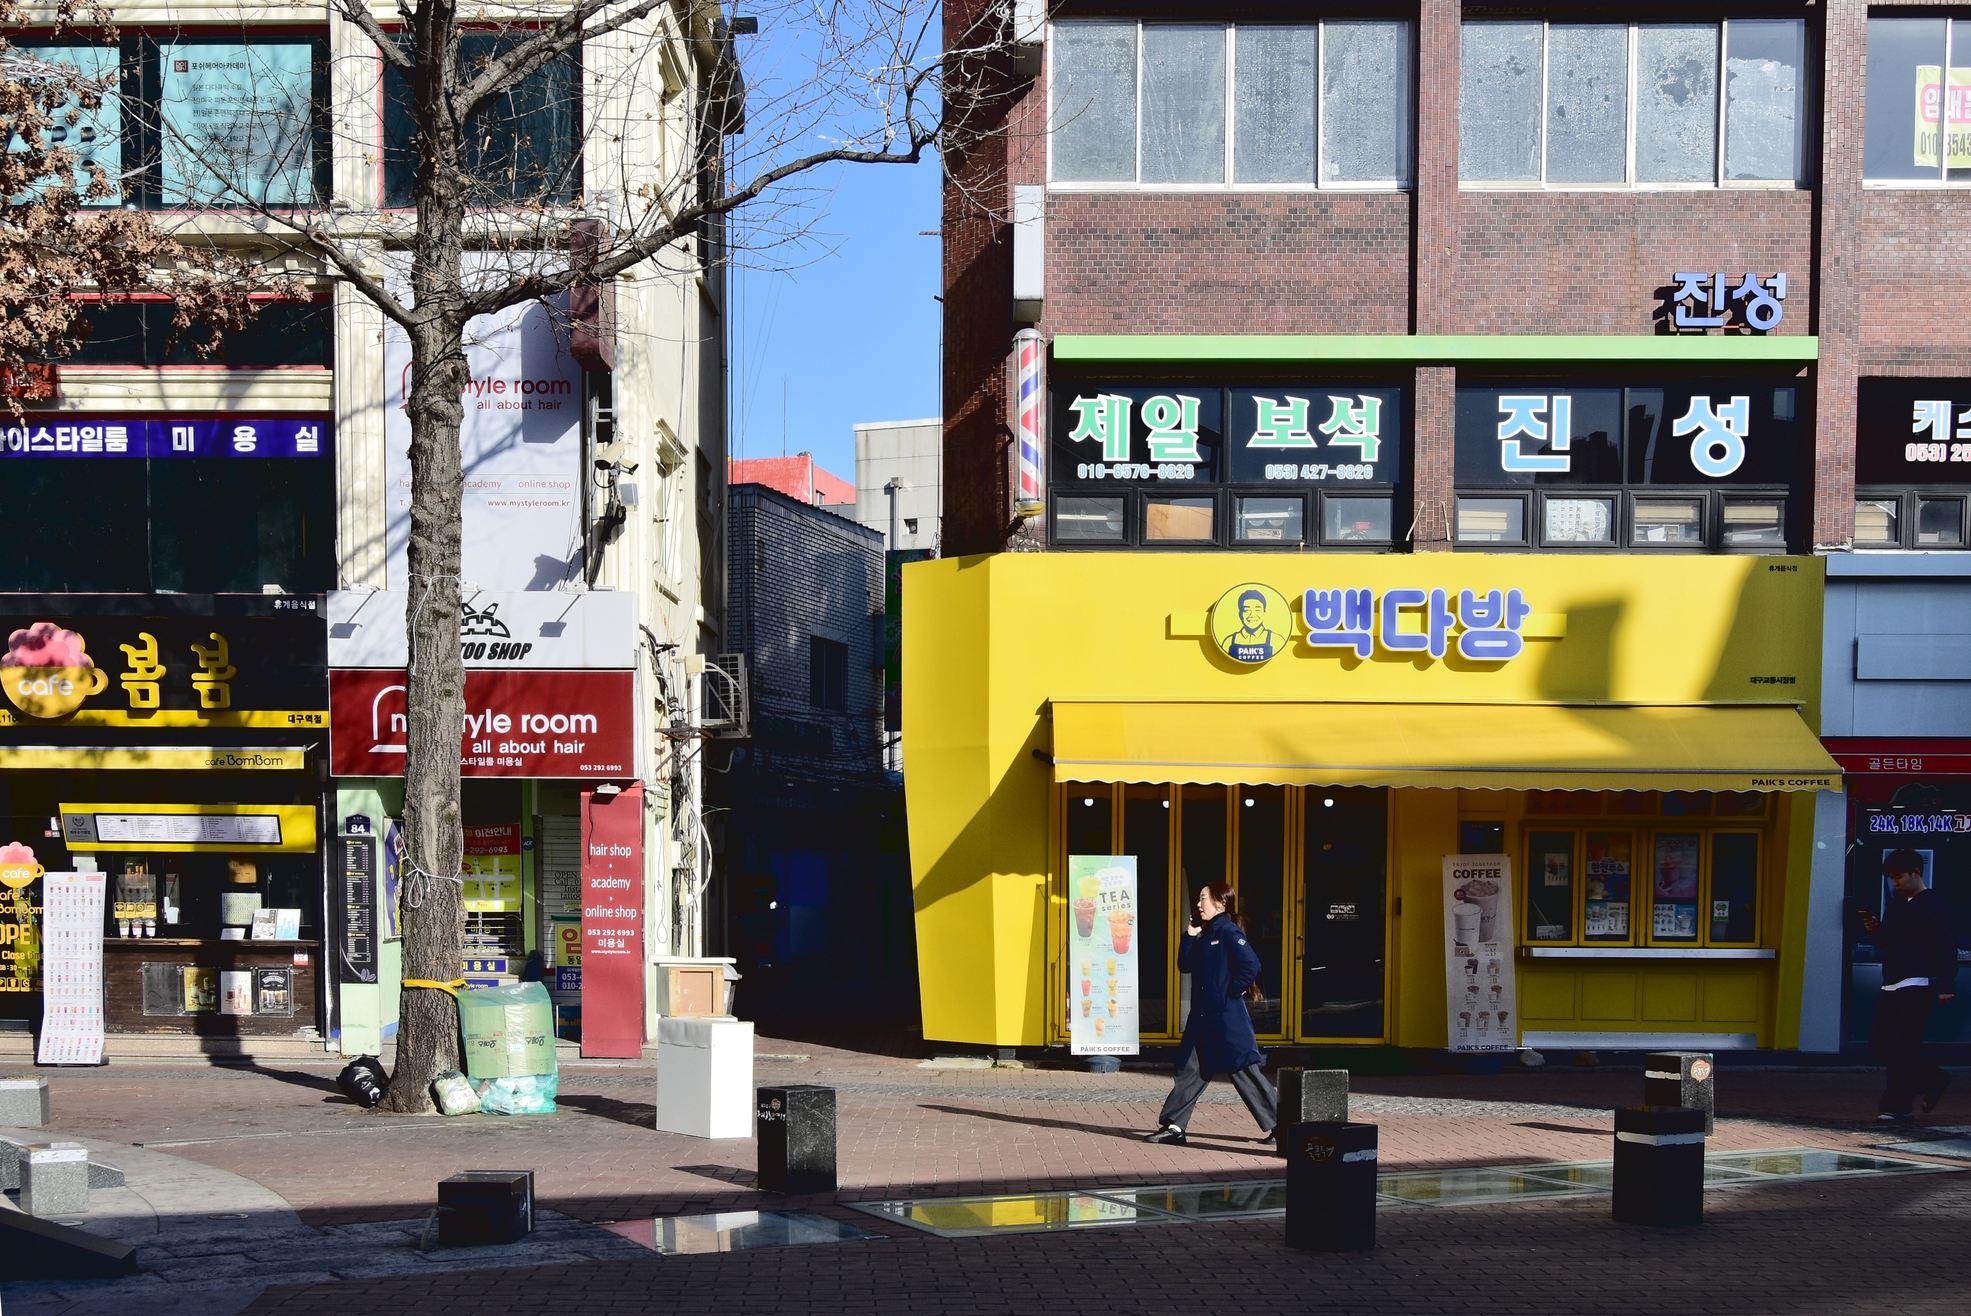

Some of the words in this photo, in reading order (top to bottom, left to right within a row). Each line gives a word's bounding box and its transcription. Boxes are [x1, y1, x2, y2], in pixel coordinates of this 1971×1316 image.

[191, 61, 247, 70] 포쉬헤어아카데미
[1673, 270, 1788, 331] 진성
[514, 379, 572, 395] room
[476, 399, 491, 410] all
[497, 399, 532, 410] about
[538, 399, 562, 410] hair
[1068, 393, 1204, 463] 제일
[1245, 394, 1384, 463] 보석
[1905, 442, 1947, 462] 053)
[1077, 463, 1195, 480] 010-8576-8826
[1265, 463, 1299, 481] 053)
[1300, 463, 1374, 480] 427-8826
[461, 479, 502, 490] academy
[518, 479, 547, 489] online
[548, 479, 571, 490] shop
[487, 499, 570, 508] www.mystyleroom.kr
[273, 599, 316, 611] 휴게음식점
[1301, 586, 1533, 661] 빽다방
[487, 641, 533, 661] SHOP
[1238, 647, 1265, 655] PAIK'S
[17, 673, 74, 696] cafe
[1750, 676, 1796, 684] 대구교통시장점
[287, 714, 323, 725] 대구역점
[521, 713, 598, 734] room
[472, 740, 491, 754] all
[499, 740, 546, 755] about
[553, 740, 586, 755] hair
[204, 757, 226, 767] cafe
[226, 754, 284, 767] BomBom
[497, 757, 523, 767] 미용실
[1868, 757, 1923, 770] 골든타임
[579, 764, 592, 772] 053
[592, 764, 605, 772] 292
[605, 764, 622, 772] 6993
[1751, 779, 1785, 787] PAIK'S
[350, 824, 366, 833] 84
[1870, 815, 1900, 834] 24K,
[475, 826, 512, 838] 이전안내
[463, 846, 508, 854] -292-6993
[589, 843, 608, 856] hair
[609, 843, 632, 858] shop
[2, 868, 31, 879] cafe
[554, 871, 578, 879] OPEN
[1452, 868, 1501, 879] COFFEE
[564, 885, 582, 893] Insta
[591, 876, 631, 891] academy
[0, 890, 21, 901] afe
[1099, 889, 1130, 904] TEA
[585, 905, 613, 918] online
[614, 905, 637, 920] shop
[1101, 902, 1131, 912] series
[598, 938, 625, 948] 미용실
[1, 950, 26, 960] Close
[1080, 1045, 1102, 1053] PAIK'S
[1103, 1045, 1130, 1053] COFFEE
